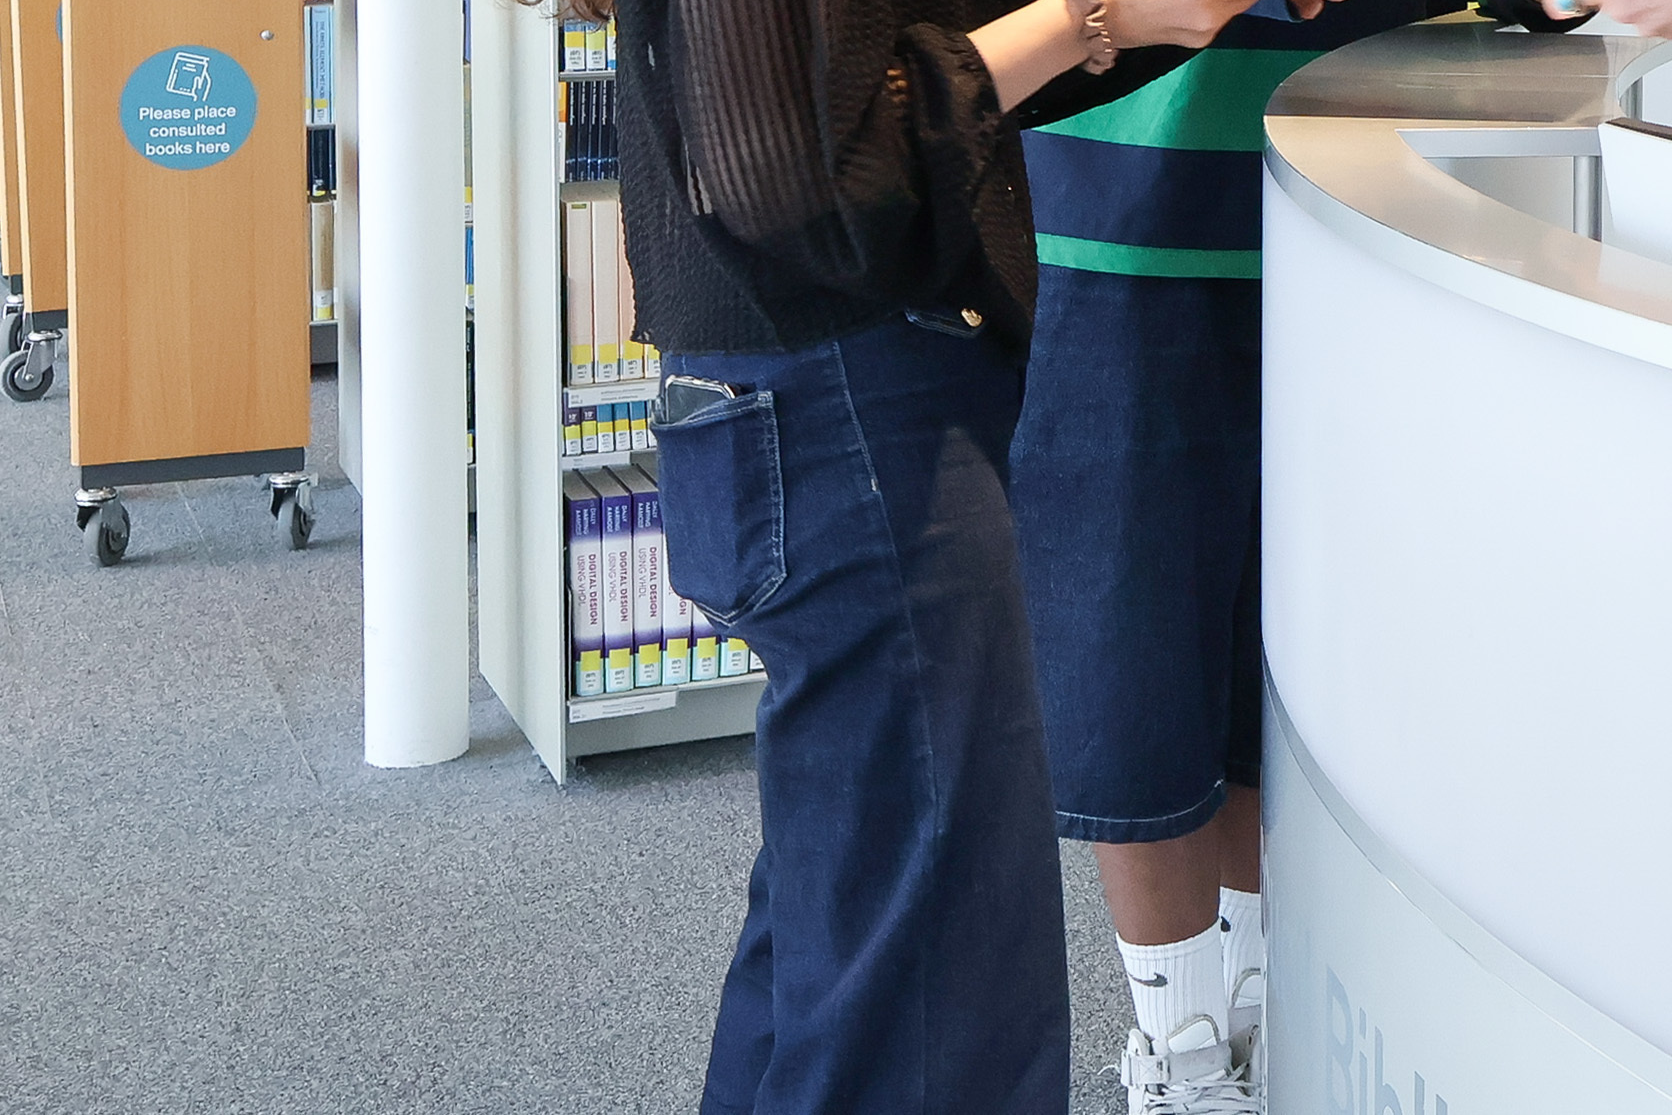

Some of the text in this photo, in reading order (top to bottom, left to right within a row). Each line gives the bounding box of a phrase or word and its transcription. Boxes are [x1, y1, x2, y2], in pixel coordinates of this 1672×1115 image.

[138, 105, 237, 124] Please place
[149, 122, 227, 138] consulted
[144, 140, 231, 156] books here
[608, 552, 616, 578] USING
[638, 548, 646, 598] USING VHDL
[649, 547, 657, 581] DIGITAL
[577, 555, 586, 606] USING VHDL
[589, 554, 598, 625] DIGITAL DESIGN
[620, 589, 628, 622] DESIGN
[679, 599, 687, 615] IGN
